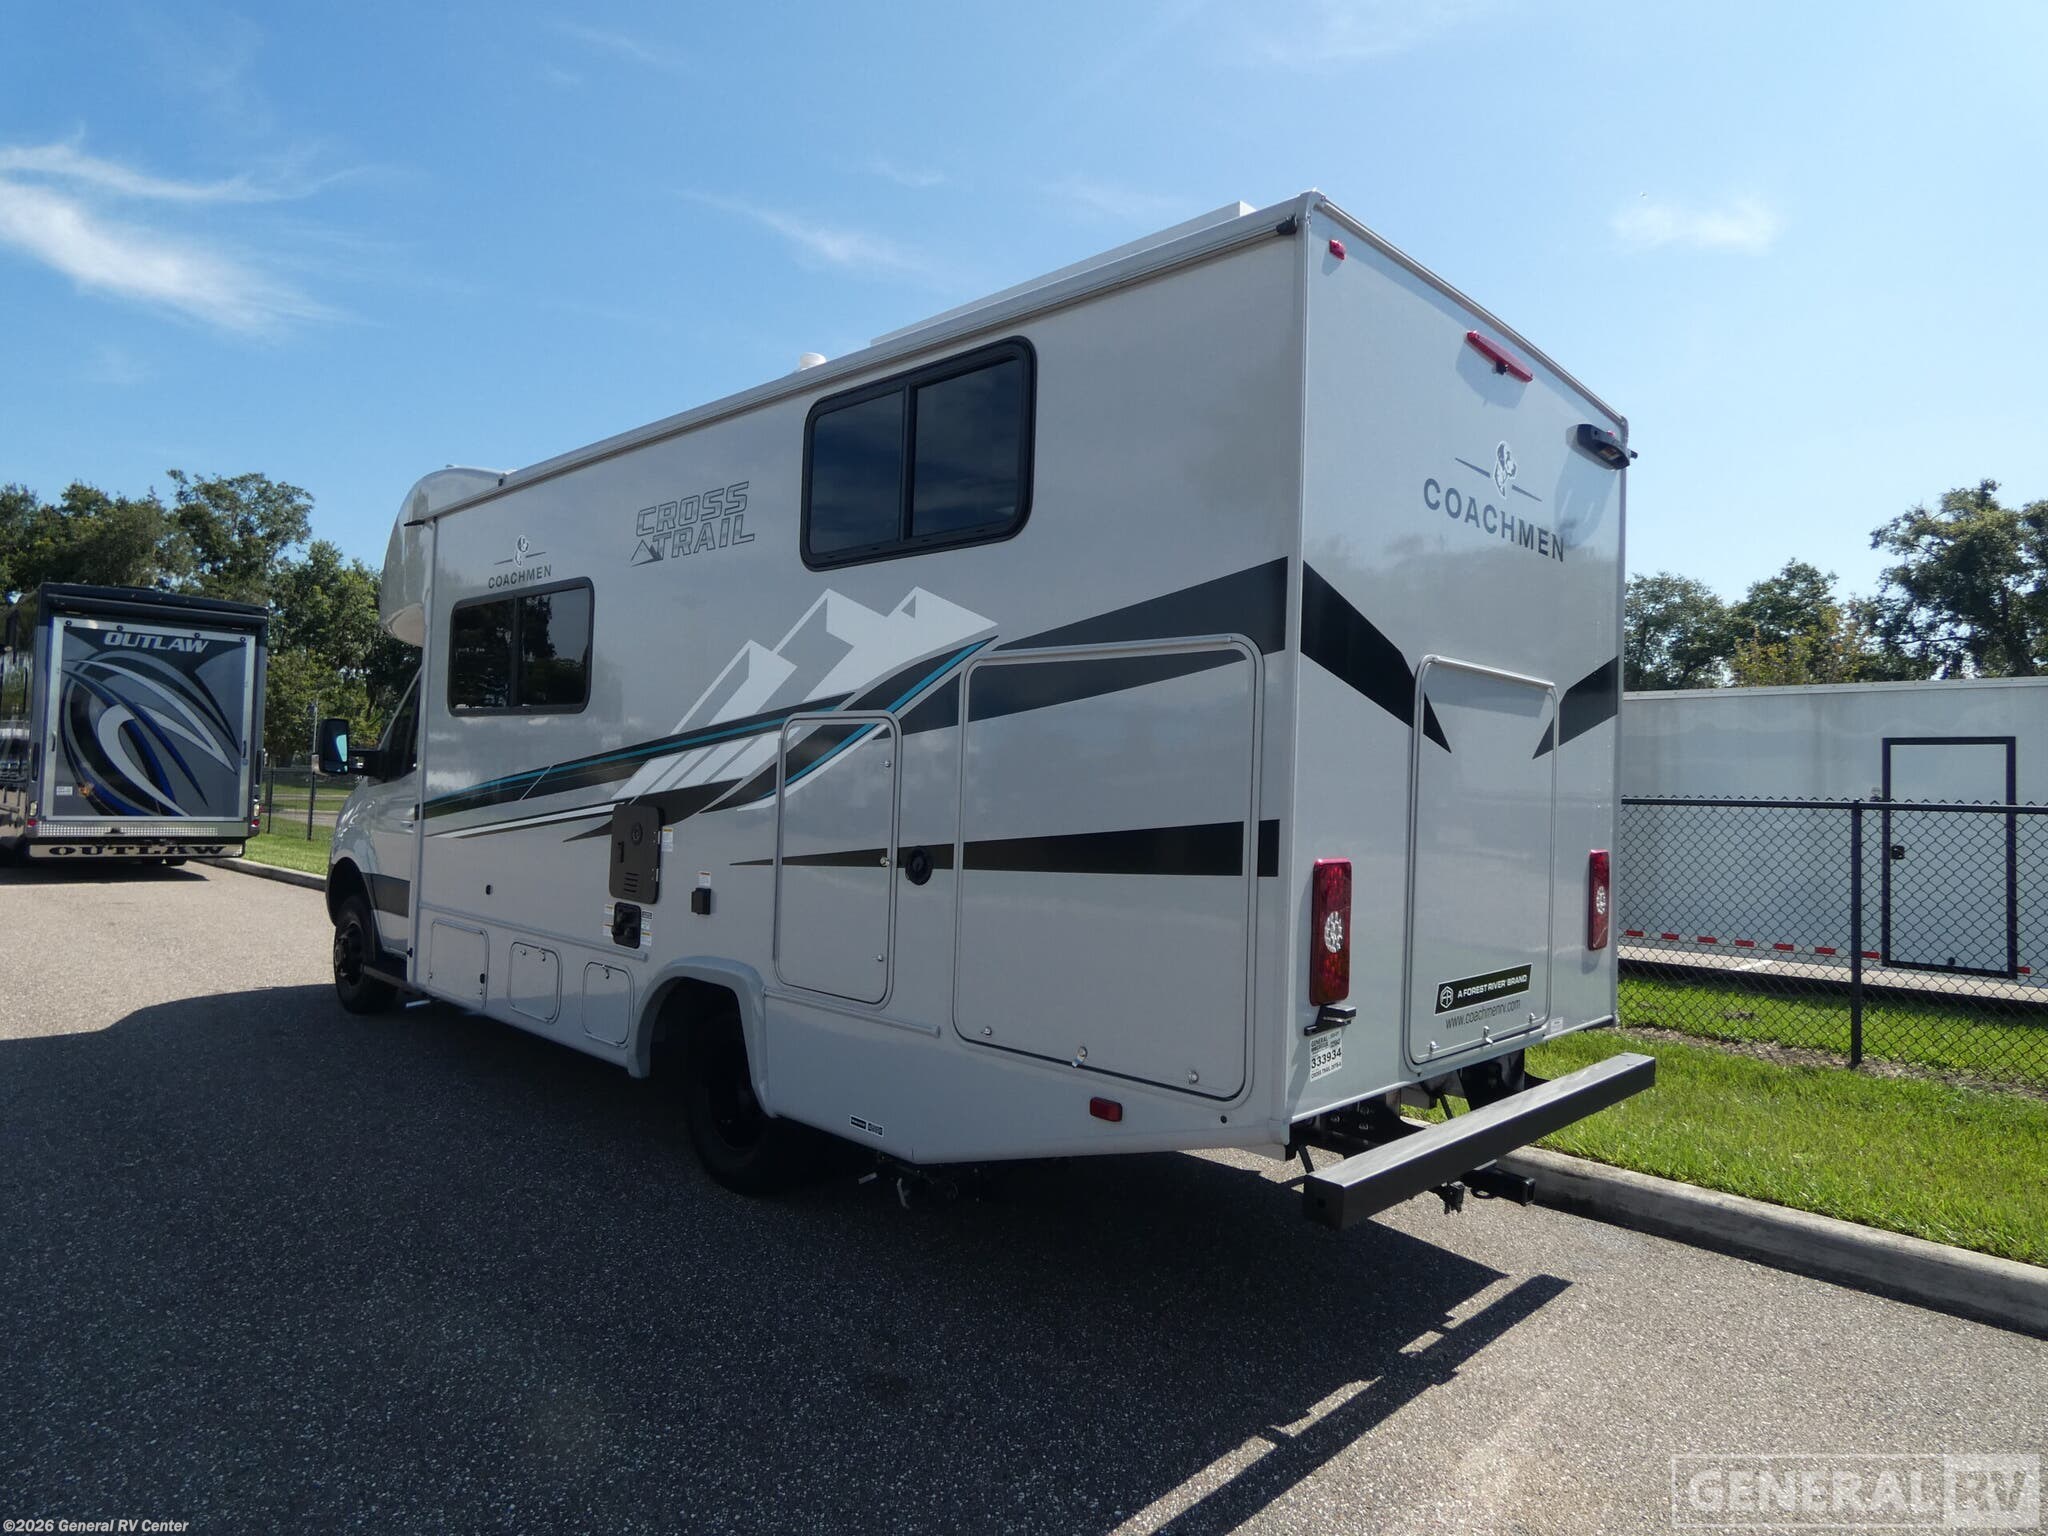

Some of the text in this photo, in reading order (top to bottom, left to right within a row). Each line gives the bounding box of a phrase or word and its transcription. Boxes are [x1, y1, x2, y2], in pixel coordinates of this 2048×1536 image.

[636, 480, 750, 538] CROSS
[1423, 477, 1565, 562] COACHMEN
[651, 513, 756, 561] TRAIL
[487, 564, 553, 590] COACHMEN
[103, 630, 209, 654] OUTLAW
[48, 843, 227, 857] OUTLAW
[1457, 974, 1528, 999] A FOREST RIVER BRAND
[1311, 1047, 1342, 1069] 333934
